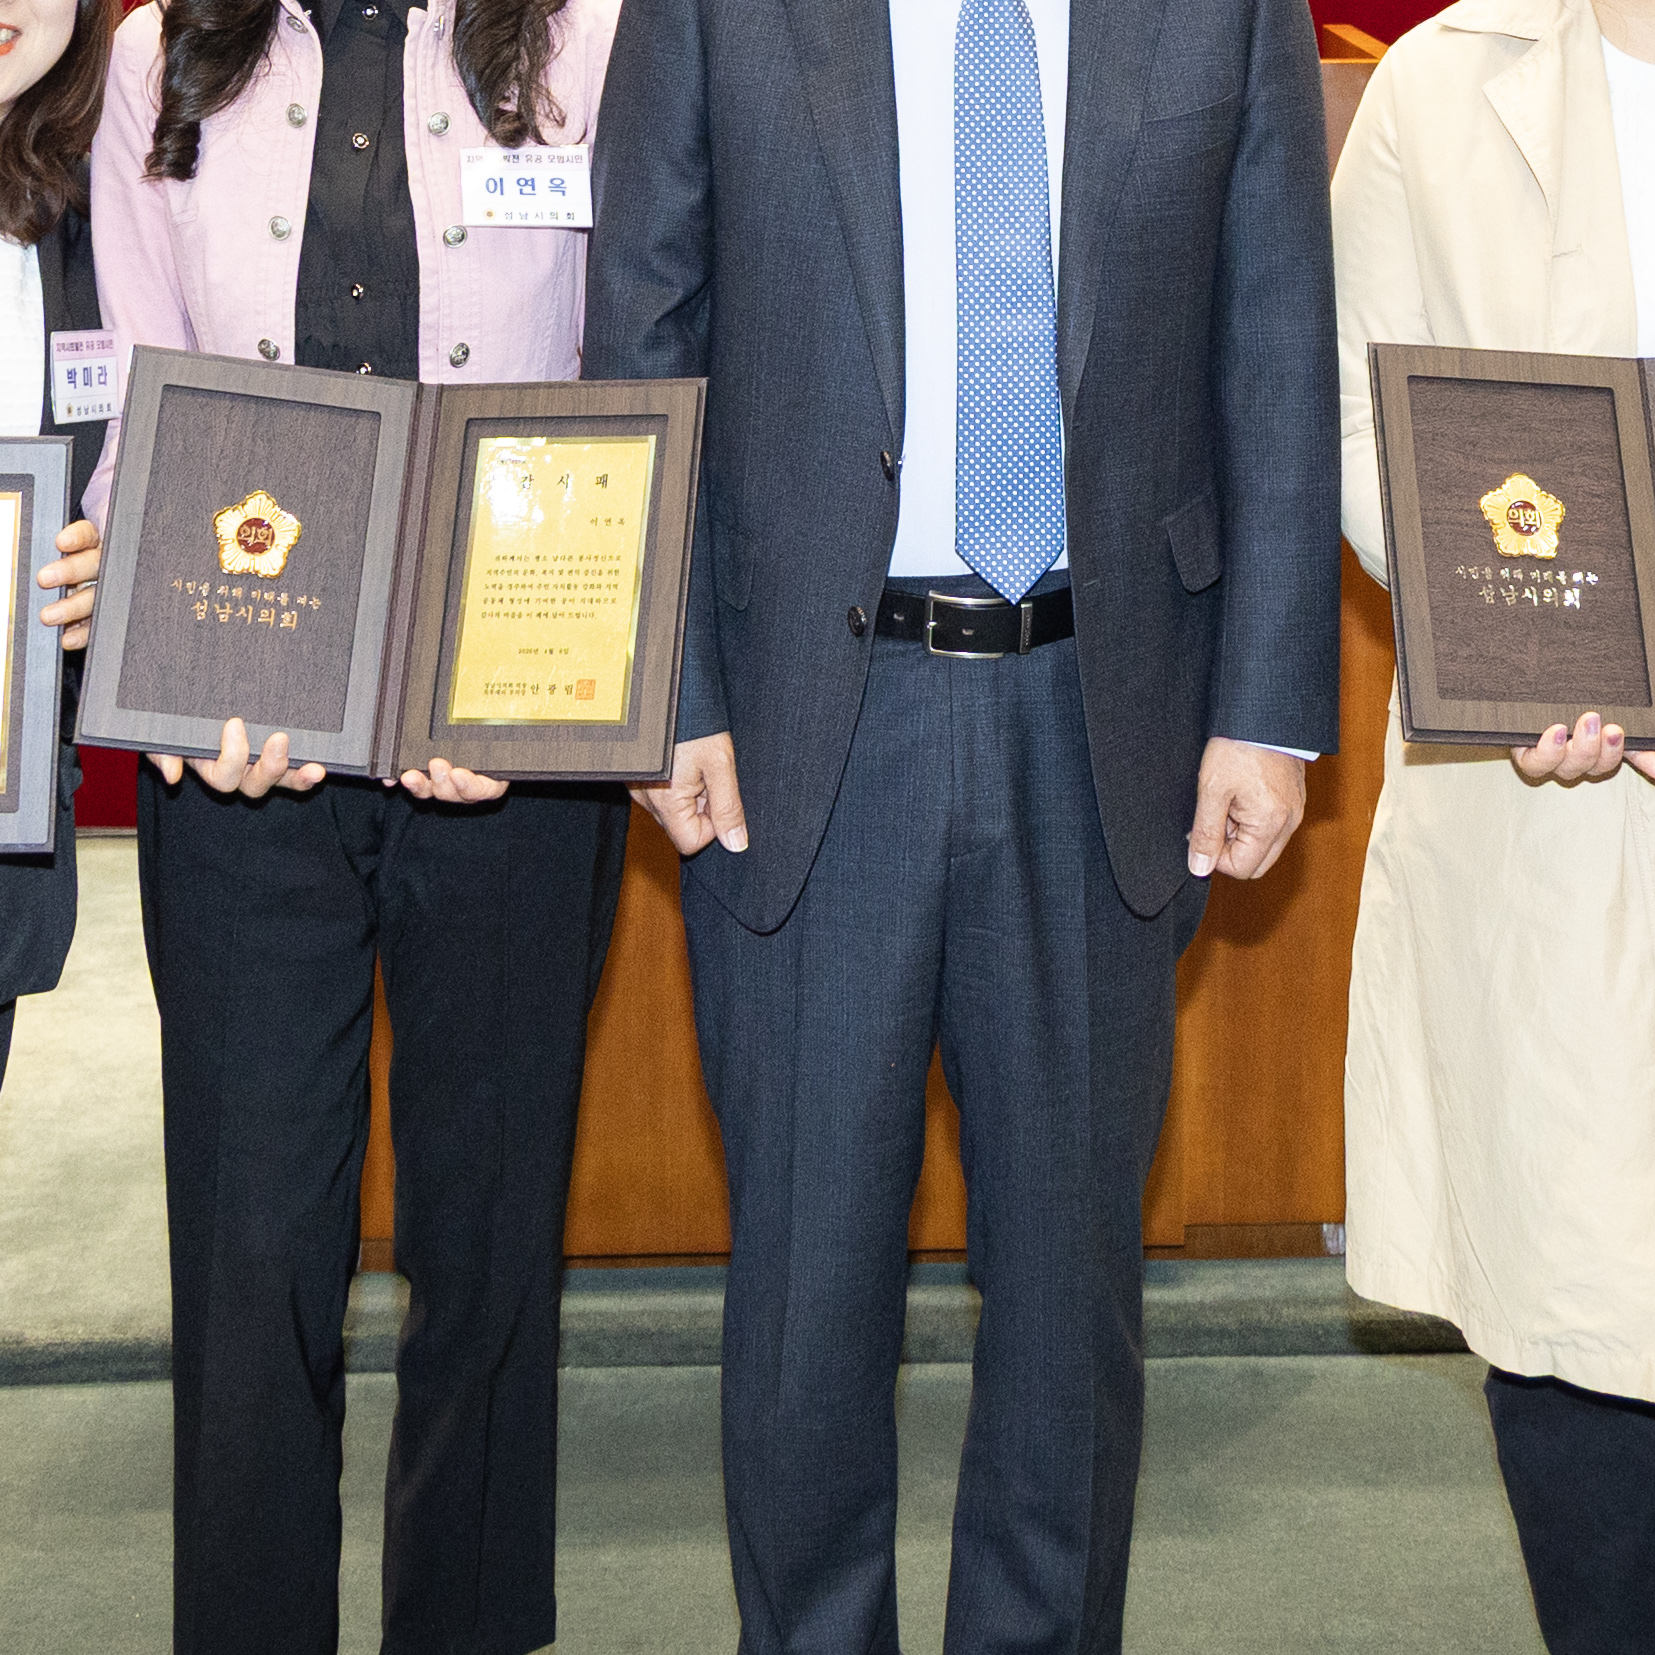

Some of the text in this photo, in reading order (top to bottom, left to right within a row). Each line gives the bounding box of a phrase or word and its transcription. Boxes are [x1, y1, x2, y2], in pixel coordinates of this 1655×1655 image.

[525, 154, 542, 164] 유공
[548, 154, 583, 164] 모범시민
[191, 599, 299, 632] 성남시의회
